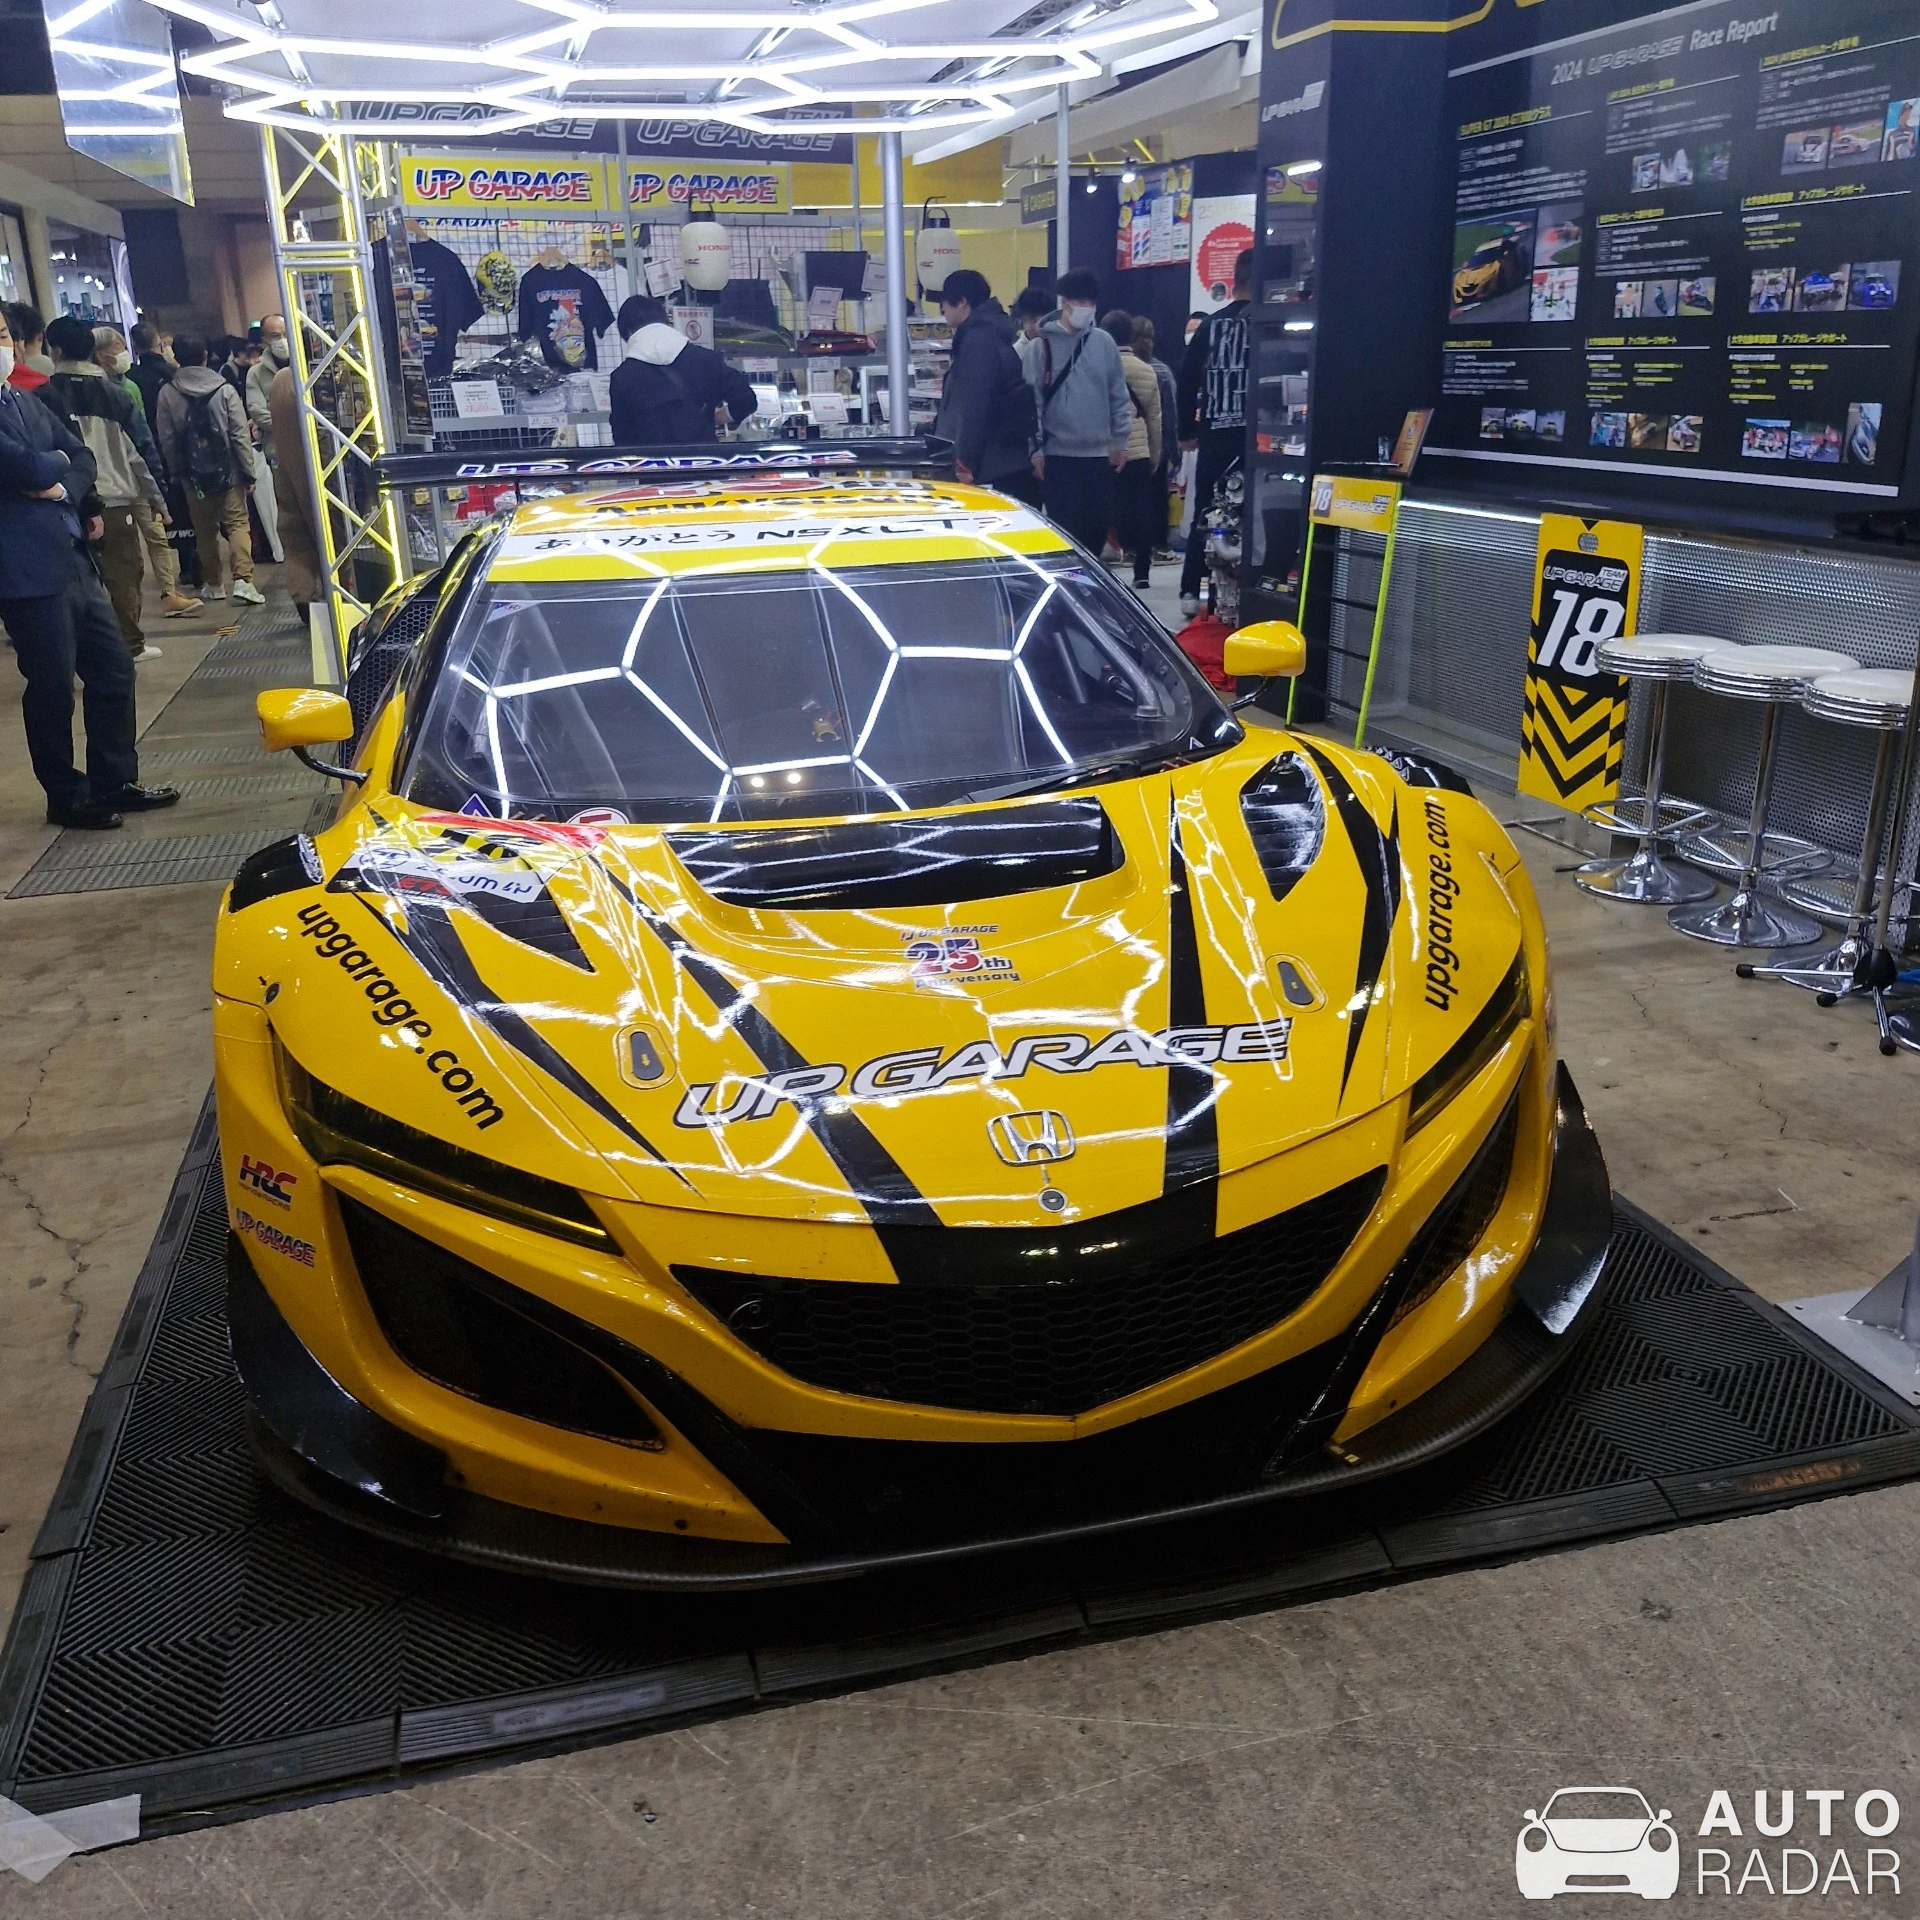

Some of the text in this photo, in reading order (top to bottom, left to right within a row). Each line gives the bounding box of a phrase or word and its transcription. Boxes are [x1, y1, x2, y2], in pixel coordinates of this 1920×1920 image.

[1551, 59, 1583, 86] 2024
[1689, 28, 1725, 52] Race
[1726, 11, 1780, 43] Report
[636, 119, 837, 152] UP GARAGE
[415, 167, 595, 202] UP GARAGE
[666, 174, 780, 204] GARAGE
[697, 244, 729, 252] HOND
[1313, 487, 1333, 511] 18
[756, 525, 878, 541] NSX
[1543, 565, 1624, 592] UP GARAGE
[1602, 567, 1627, 580] TEAM
[1536, 589, 1626, 677] 18
[1424, 800, 1461, 1013] upgarage.com
[941, 925, 999, 936] GARAGE
[904, 936, 1013, 977] 25th
[296, 903, 506, 1131] upgarage.com
[673, 1017, 1295, 1131] UP GARAGE
[239, 1153, 299, 1205] HRC
[256, 1219, 317, 1268] GARAGE
